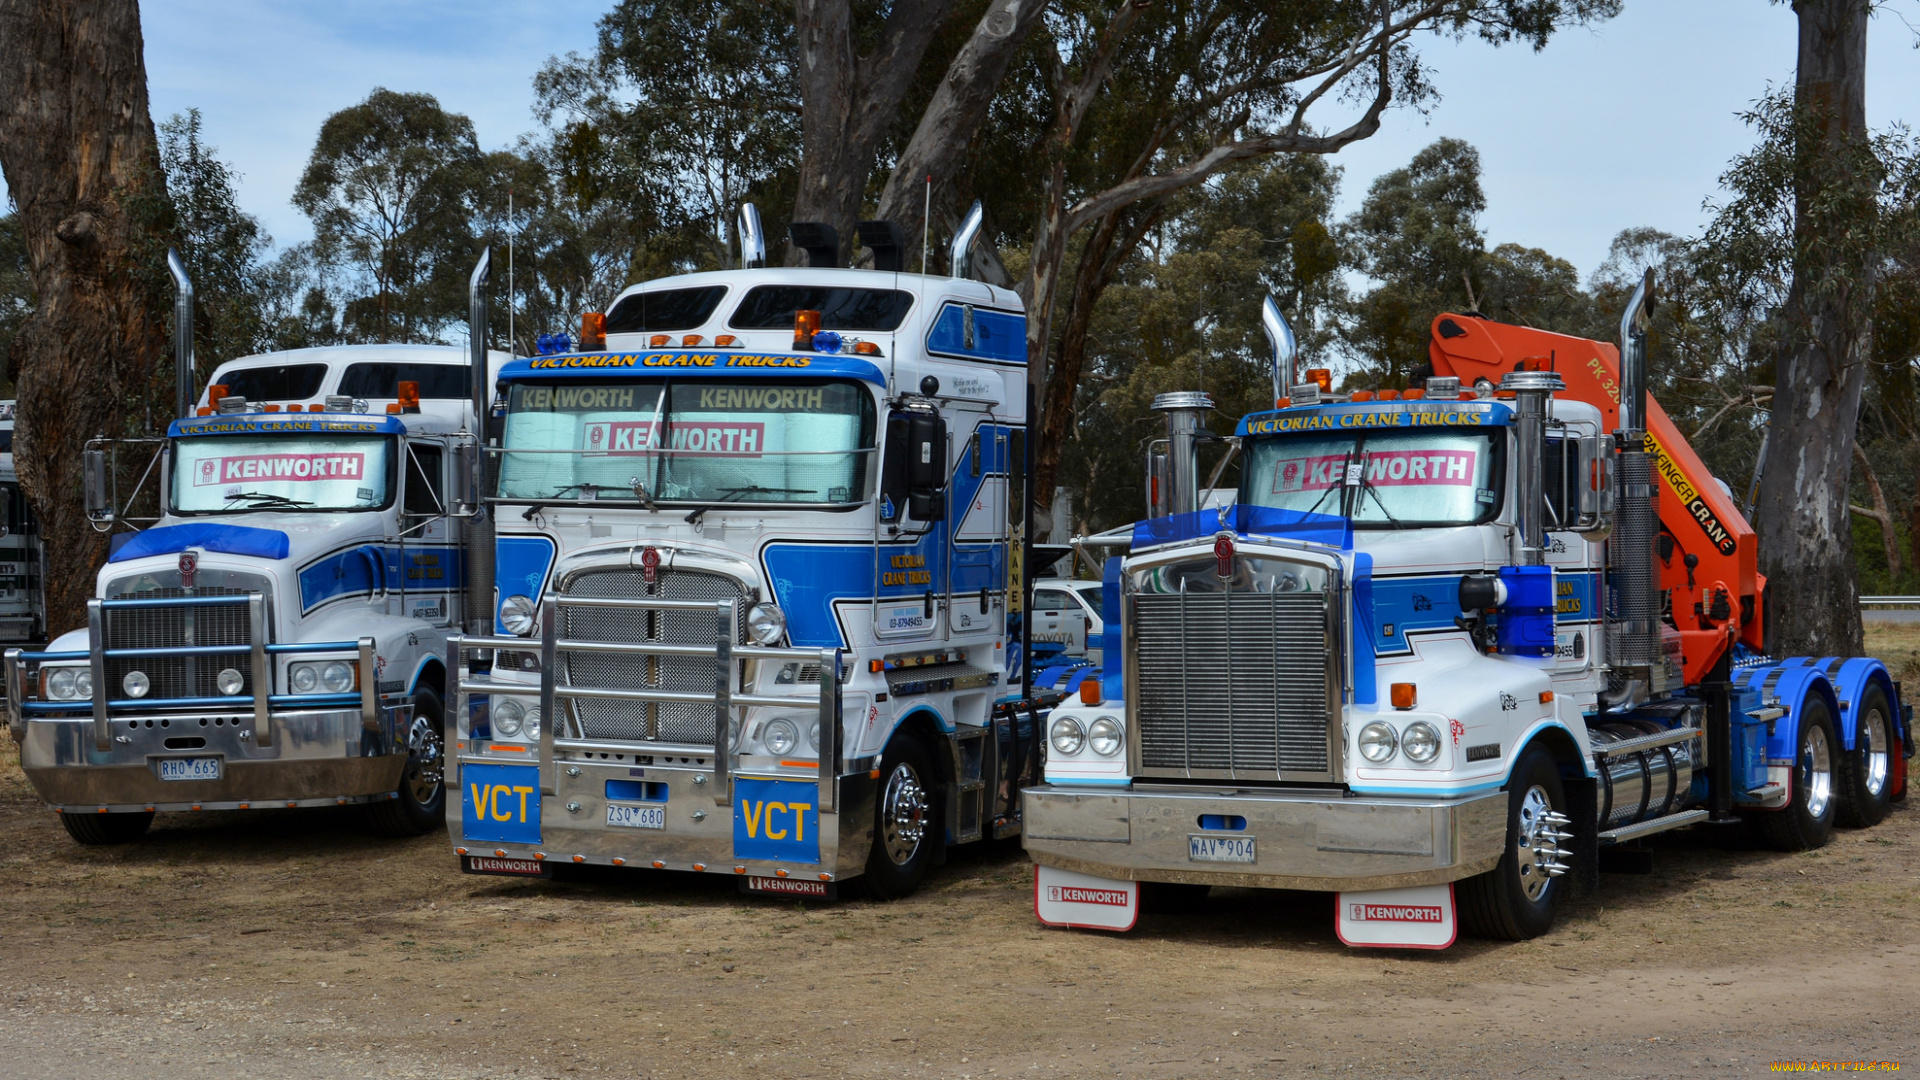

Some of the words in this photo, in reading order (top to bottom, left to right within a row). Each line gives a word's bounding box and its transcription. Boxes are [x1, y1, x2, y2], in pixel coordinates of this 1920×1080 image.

[529, 354, 638, 370] VICTORIAN
[643, 354, 717, 367] CRANE
[726, 355, 812, 368] TRUCKS
[1587, 358, 1607, 379] PK
[522, 388, 634, 408] KENWORTH
[700, 388, 823, 408] KENWORTH
[180, 423, 256, 434] VICTORIAN
[262, 422, 311, 431] CRANE
[319, 422, 377, 432] TRUCKS
[1247, 415, 1335, 434] VICTORIAN
[1340, 412, 1401, 428] CRANE
[1410, 412, 1482, 426] TRUCKS
[226, 457, 358, 479] KENWORTH
[1310, 456, 1468, 484] KEWORTH
[1690, 500, 1734, 552] CRANE
[891, 555, 925, 568] VICTORIAN
[883, 572, 906, 586] CRANE
[908, 570, 931, 584] TRUCKS
[1031, 632, 1074, 646] TOYOTA
[162, 762, 185, 775] RHO
[195, 761, 216, 774] 665
[470, 782, 533, 824] VCT
[609, 807, 630, 822] ZSQ
[642, 810, 663, 824] 680
[742, 800, 811, 841] VCT
[1191, 839, 1216, 855] WAV
[1228, 841, 1252, 857] 904
[483, 859, 541, 873] KENWORTH
[763, 880, 825, 894] KENWORTH
[1062, 889, 1127, 905] KENWORTH
[1367, 906, 1442, 922] KENWORTH
